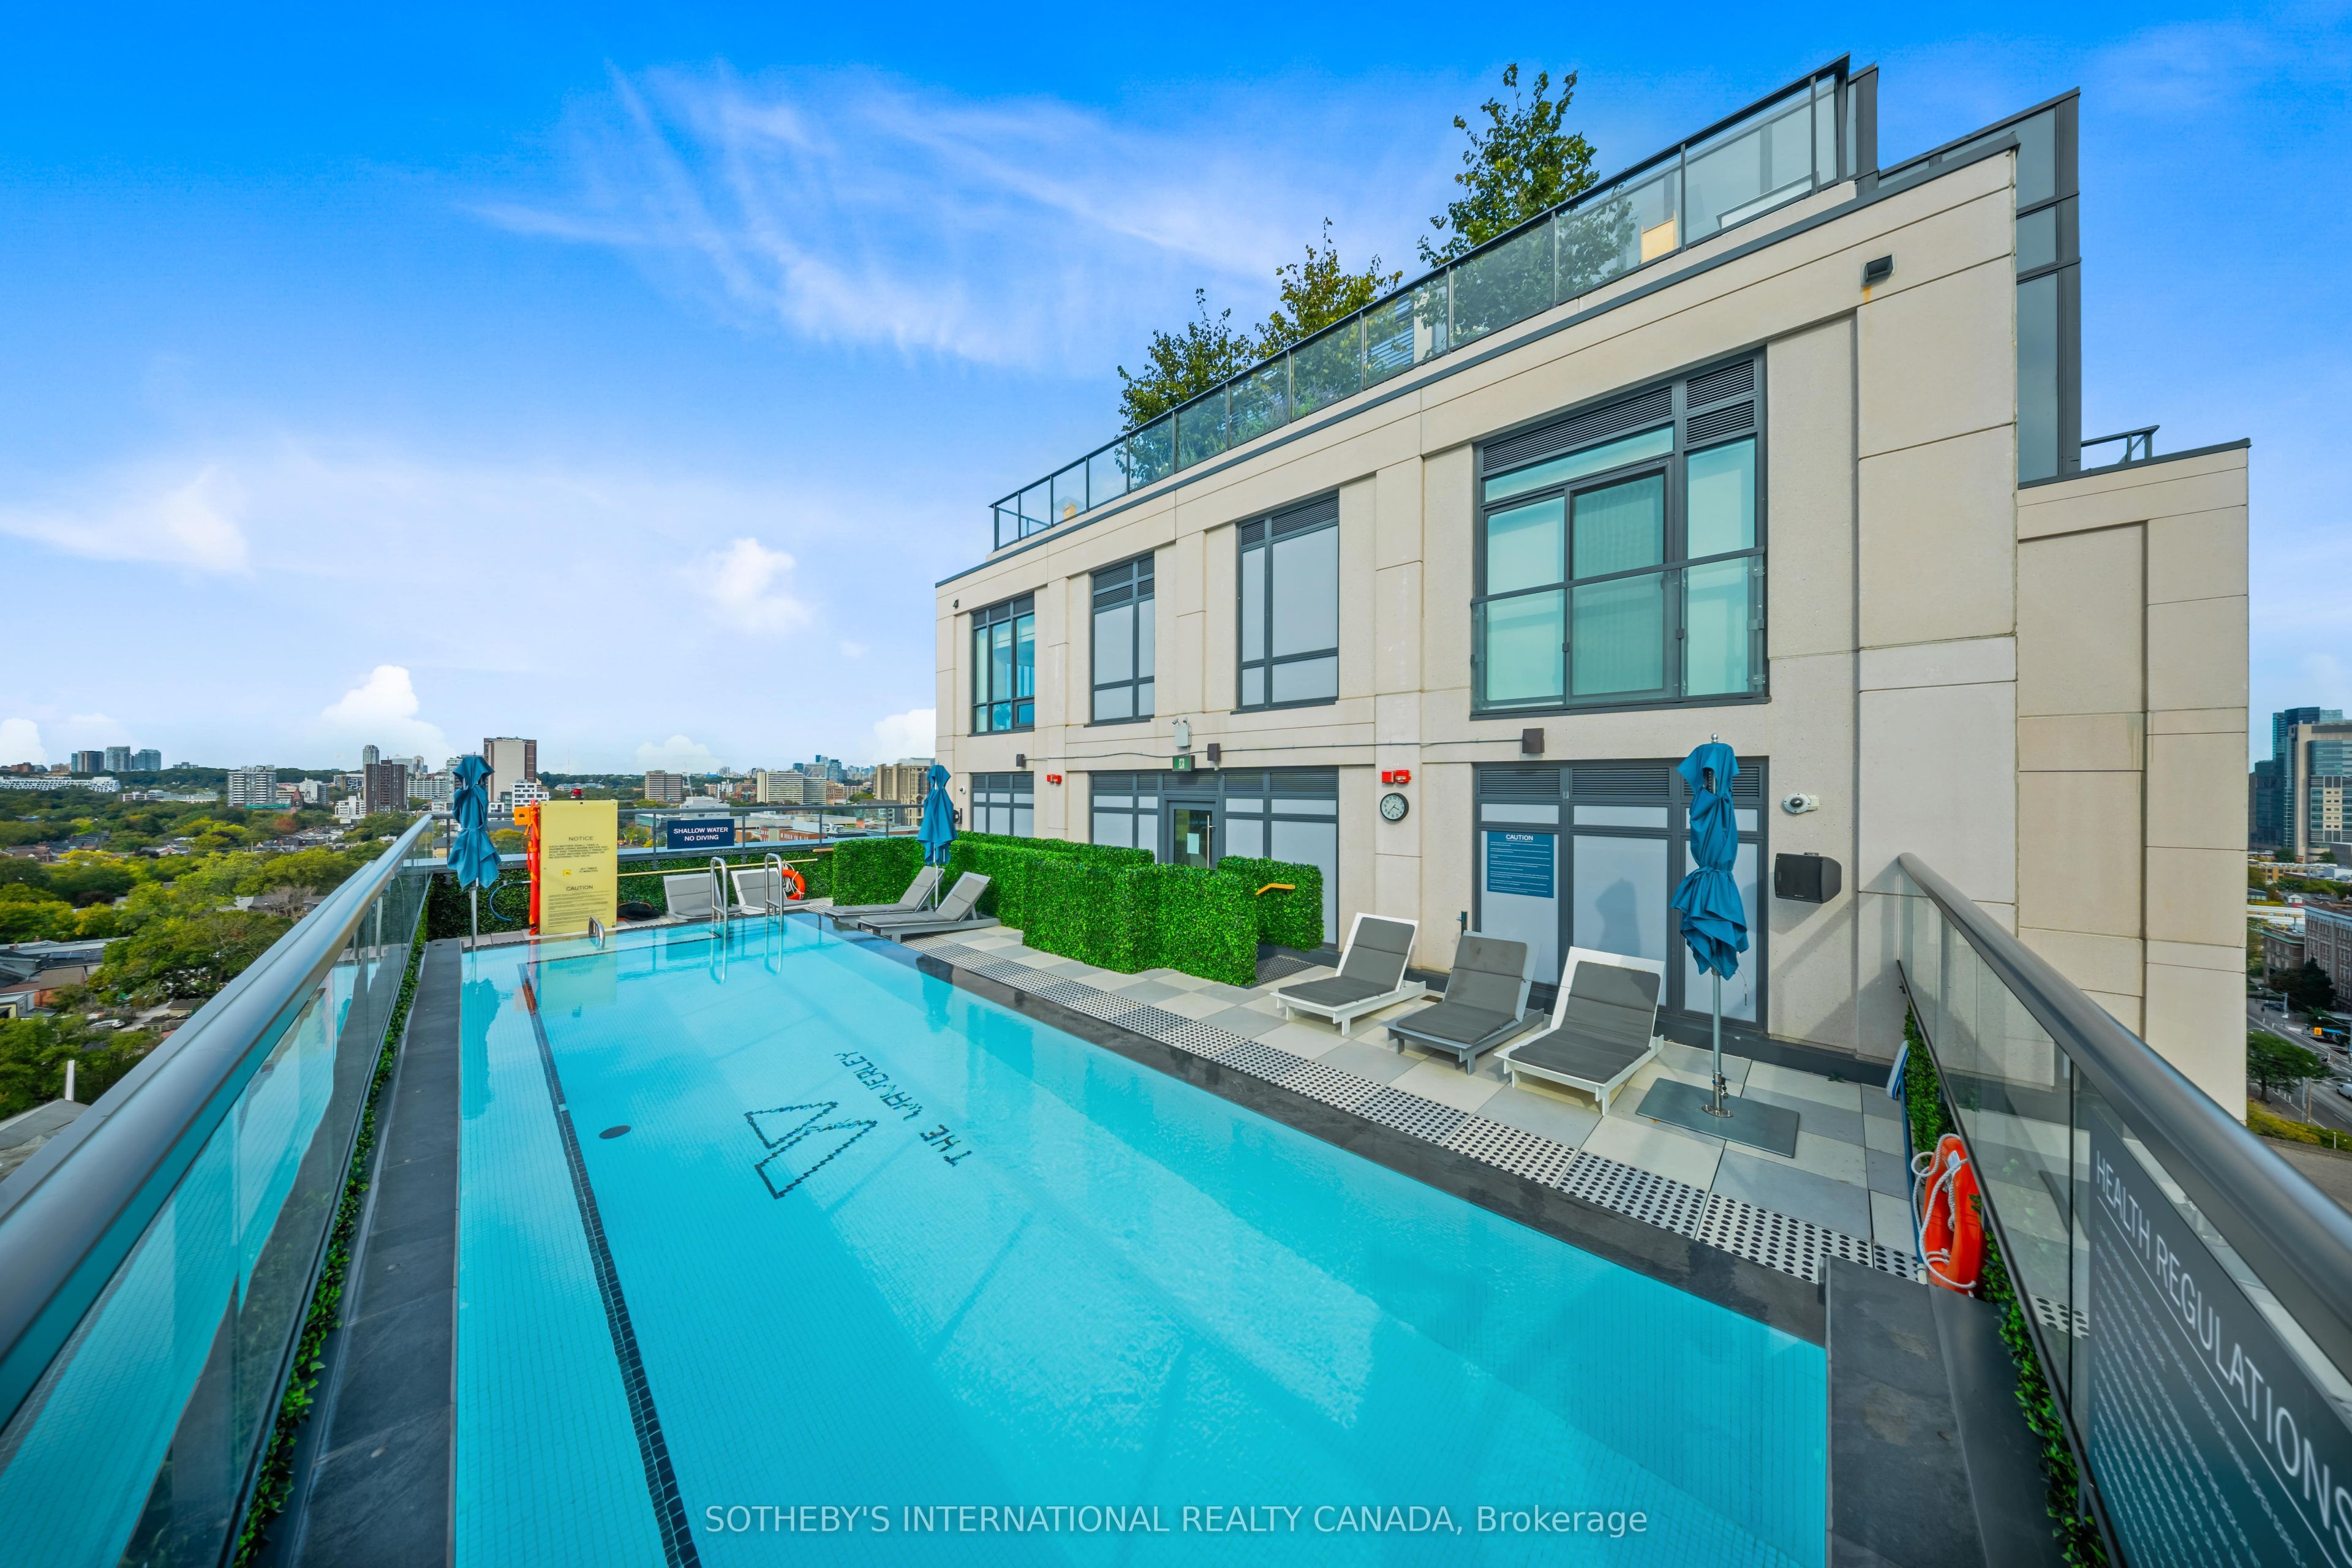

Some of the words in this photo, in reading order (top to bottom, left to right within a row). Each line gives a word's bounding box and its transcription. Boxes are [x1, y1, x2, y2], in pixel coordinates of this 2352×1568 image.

[834, 1052, 922, 1121] WAVERLEY
[919, 1124, 973, 1167] THE
[2097, 1151, 2150, 1259] HEALTH
[2157, 1234, 2352, 1567] REGULATIONS
